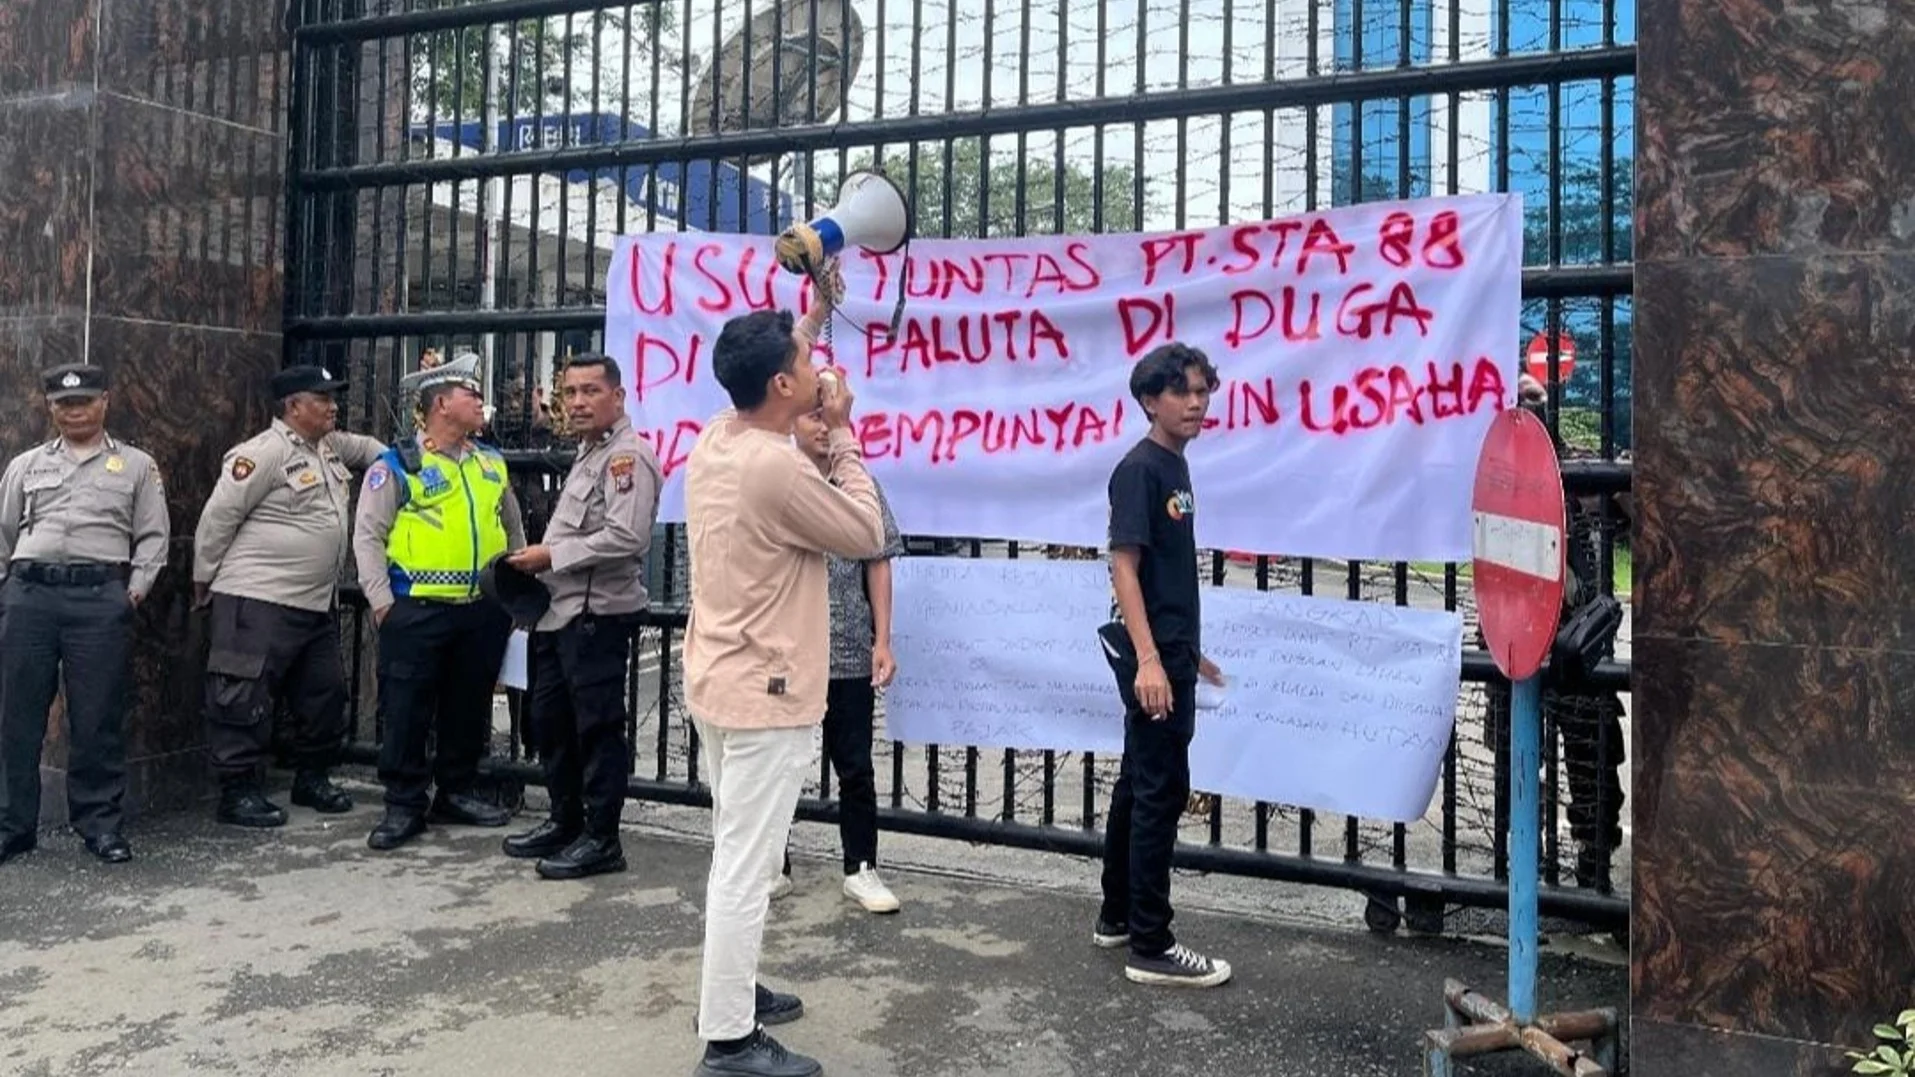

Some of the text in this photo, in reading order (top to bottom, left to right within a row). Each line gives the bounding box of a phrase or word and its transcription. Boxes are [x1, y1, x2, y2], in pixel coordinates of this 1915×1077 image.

[859, 243, 1100, 300] TUNTAS
[1378, 210, 1465, 269] 88
[636, 332, 702, 401] DI
[866, 309, 1069, 378] PALUTA
[1117, 293, 1176, 356] DI
[1223, 281, 1433, 348] DUGA
[848, 402, 1123, 464] EMPUNYAI
[1299, 357, 1505, 434] USAHA
